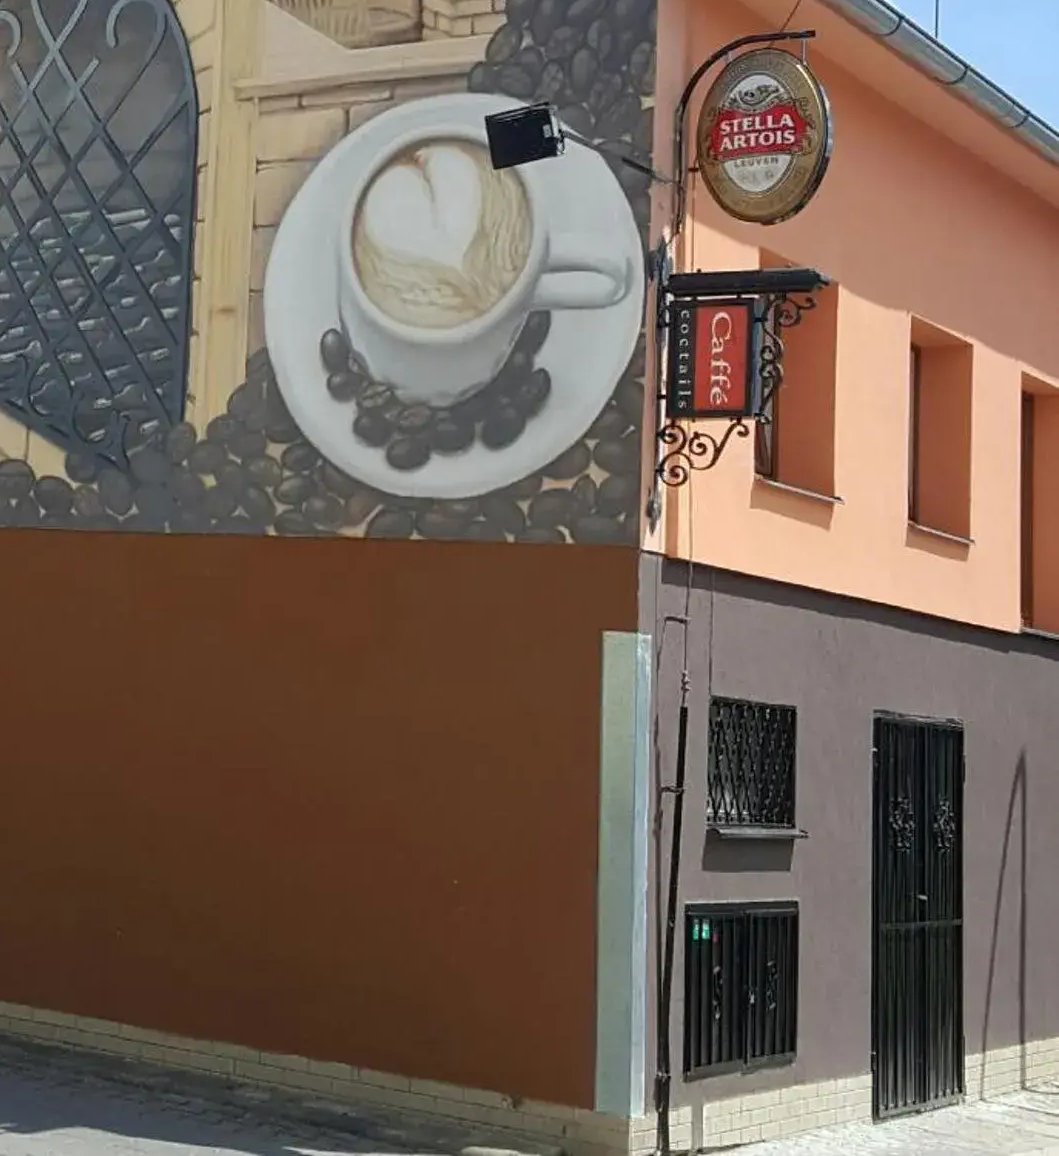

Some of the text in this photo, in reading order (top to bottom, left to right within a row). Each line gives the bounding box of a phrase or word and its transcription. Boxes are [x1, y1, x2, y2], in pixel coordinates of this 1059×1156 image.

[720, 113, 795, 135] STELLA
[720, 129, 796, 152] ARTOIS
[679, 310, 691, 408] coctails
[711, 312, 732, 405] Caffé
